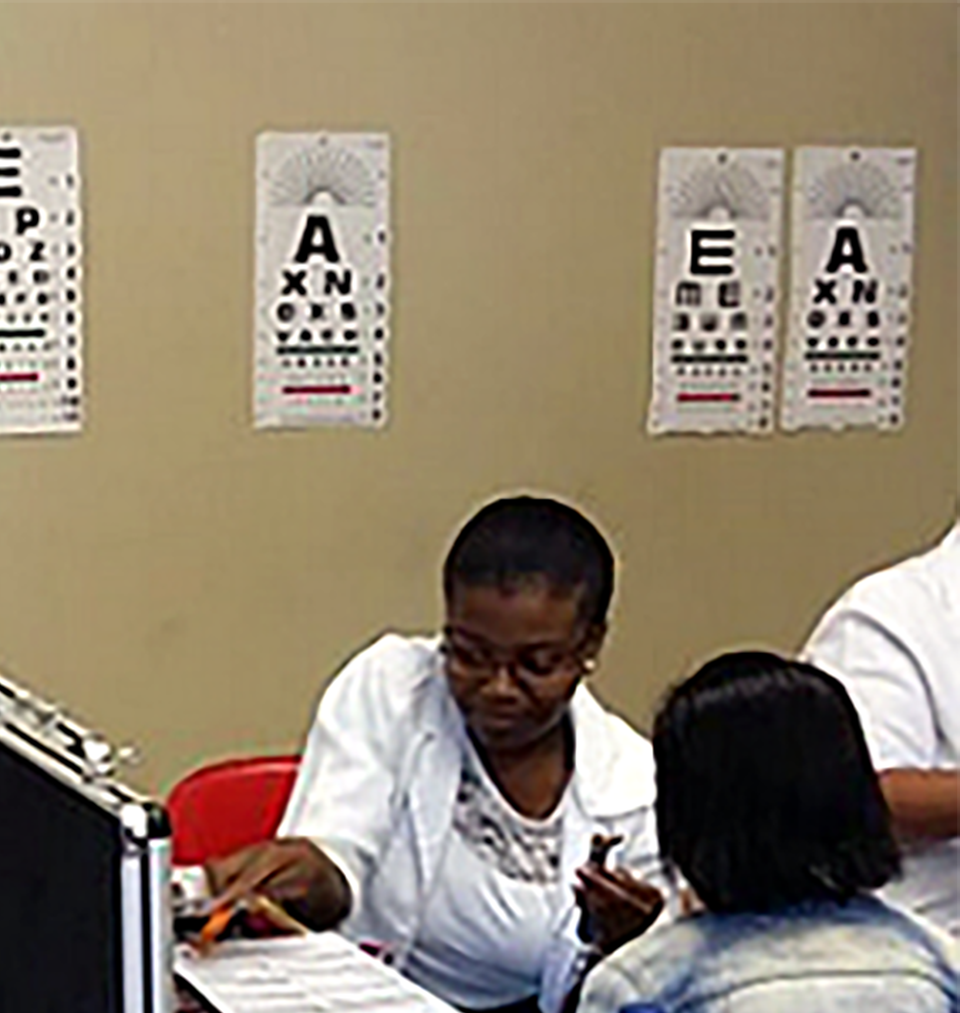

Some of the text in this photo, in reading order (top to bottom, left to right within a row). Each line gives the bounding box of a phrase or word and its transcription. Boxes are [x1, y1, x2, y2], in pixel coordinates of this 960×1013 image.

[15, 207, 41, 236] P
[293, 214, 341, 264] A
[690, 229, 736, 276] E
[824, 226, 869, 274] A
[281, 269, 352, 297] X N
[812, 278, 880, 305] X N
